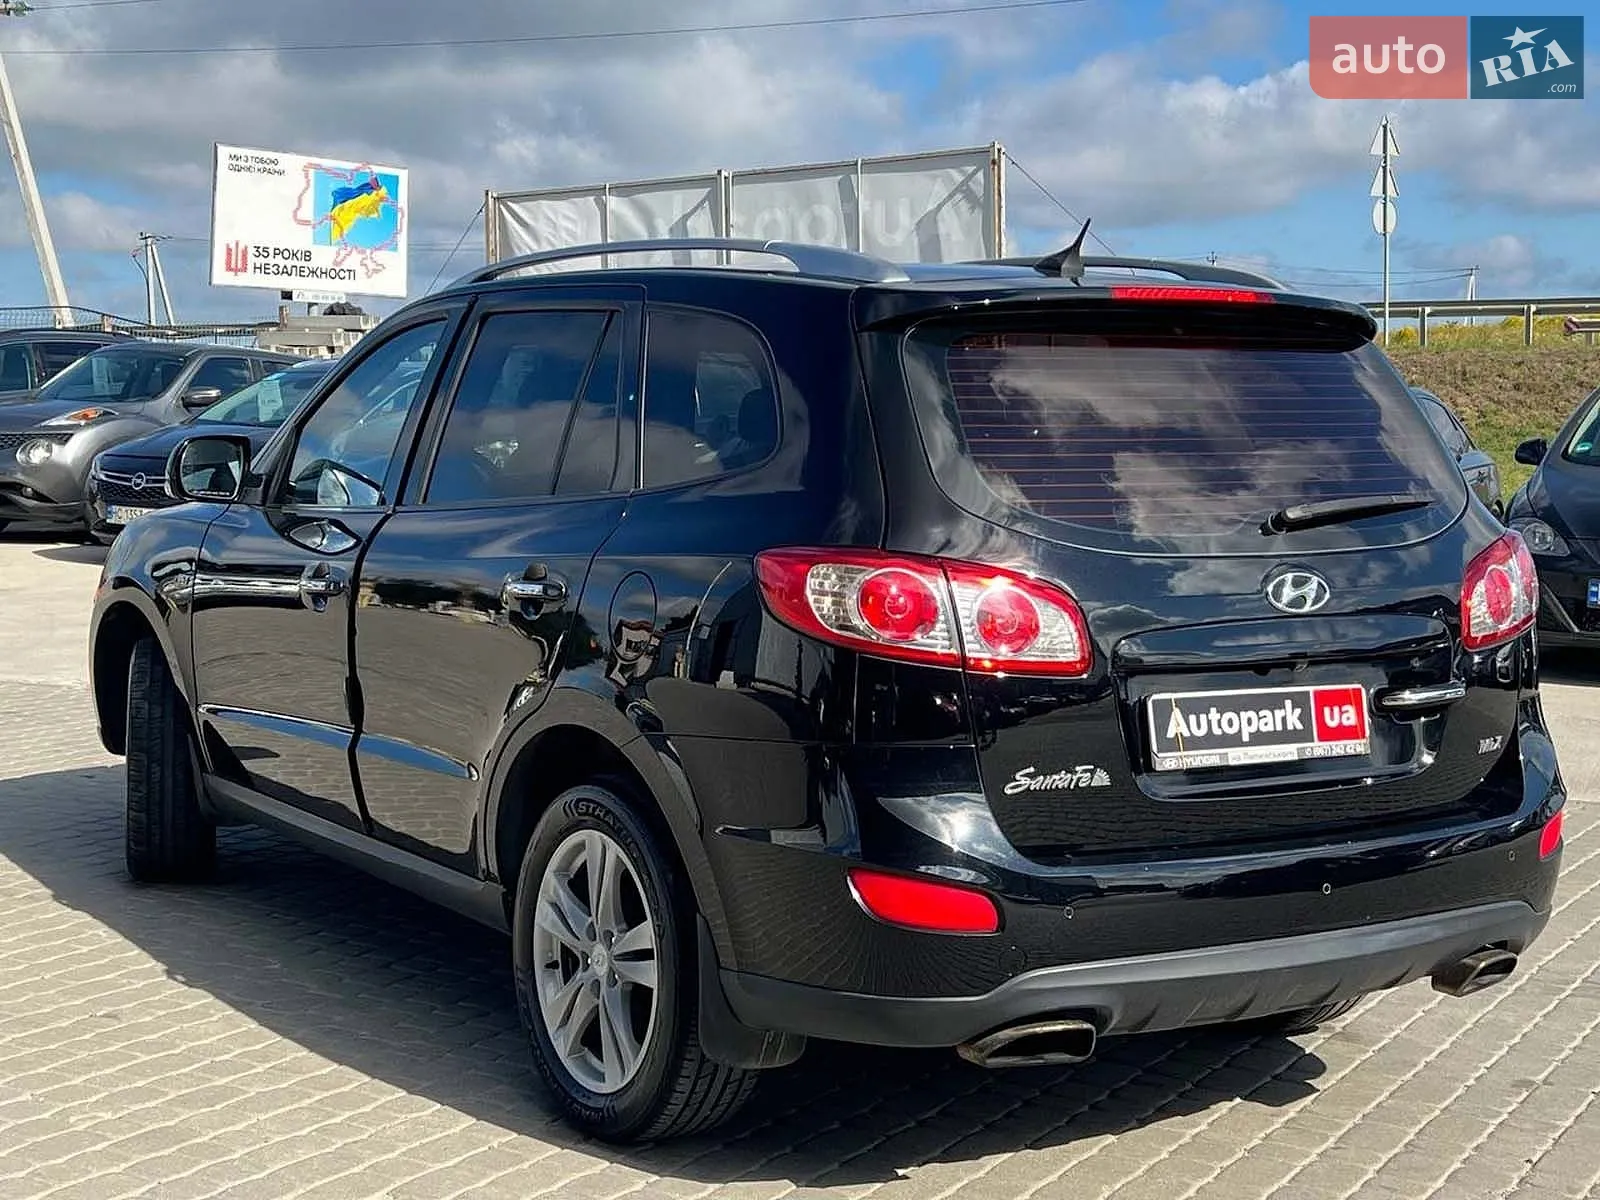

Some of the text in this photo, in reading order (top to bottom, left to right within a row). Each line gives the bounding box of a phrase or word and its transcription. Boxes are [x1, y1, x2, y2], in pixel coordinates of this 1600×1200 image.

[228, 153, 242, 162] МИ
[250, 155, 279, 166] ТОБОЮ
[253, 246, 312, 262] 35 РОКІВ
[253, 262, 356, 280] НЕЗАЛЕЖНОСТІ
[1166, 699, 1358, 742] Autopark ua
